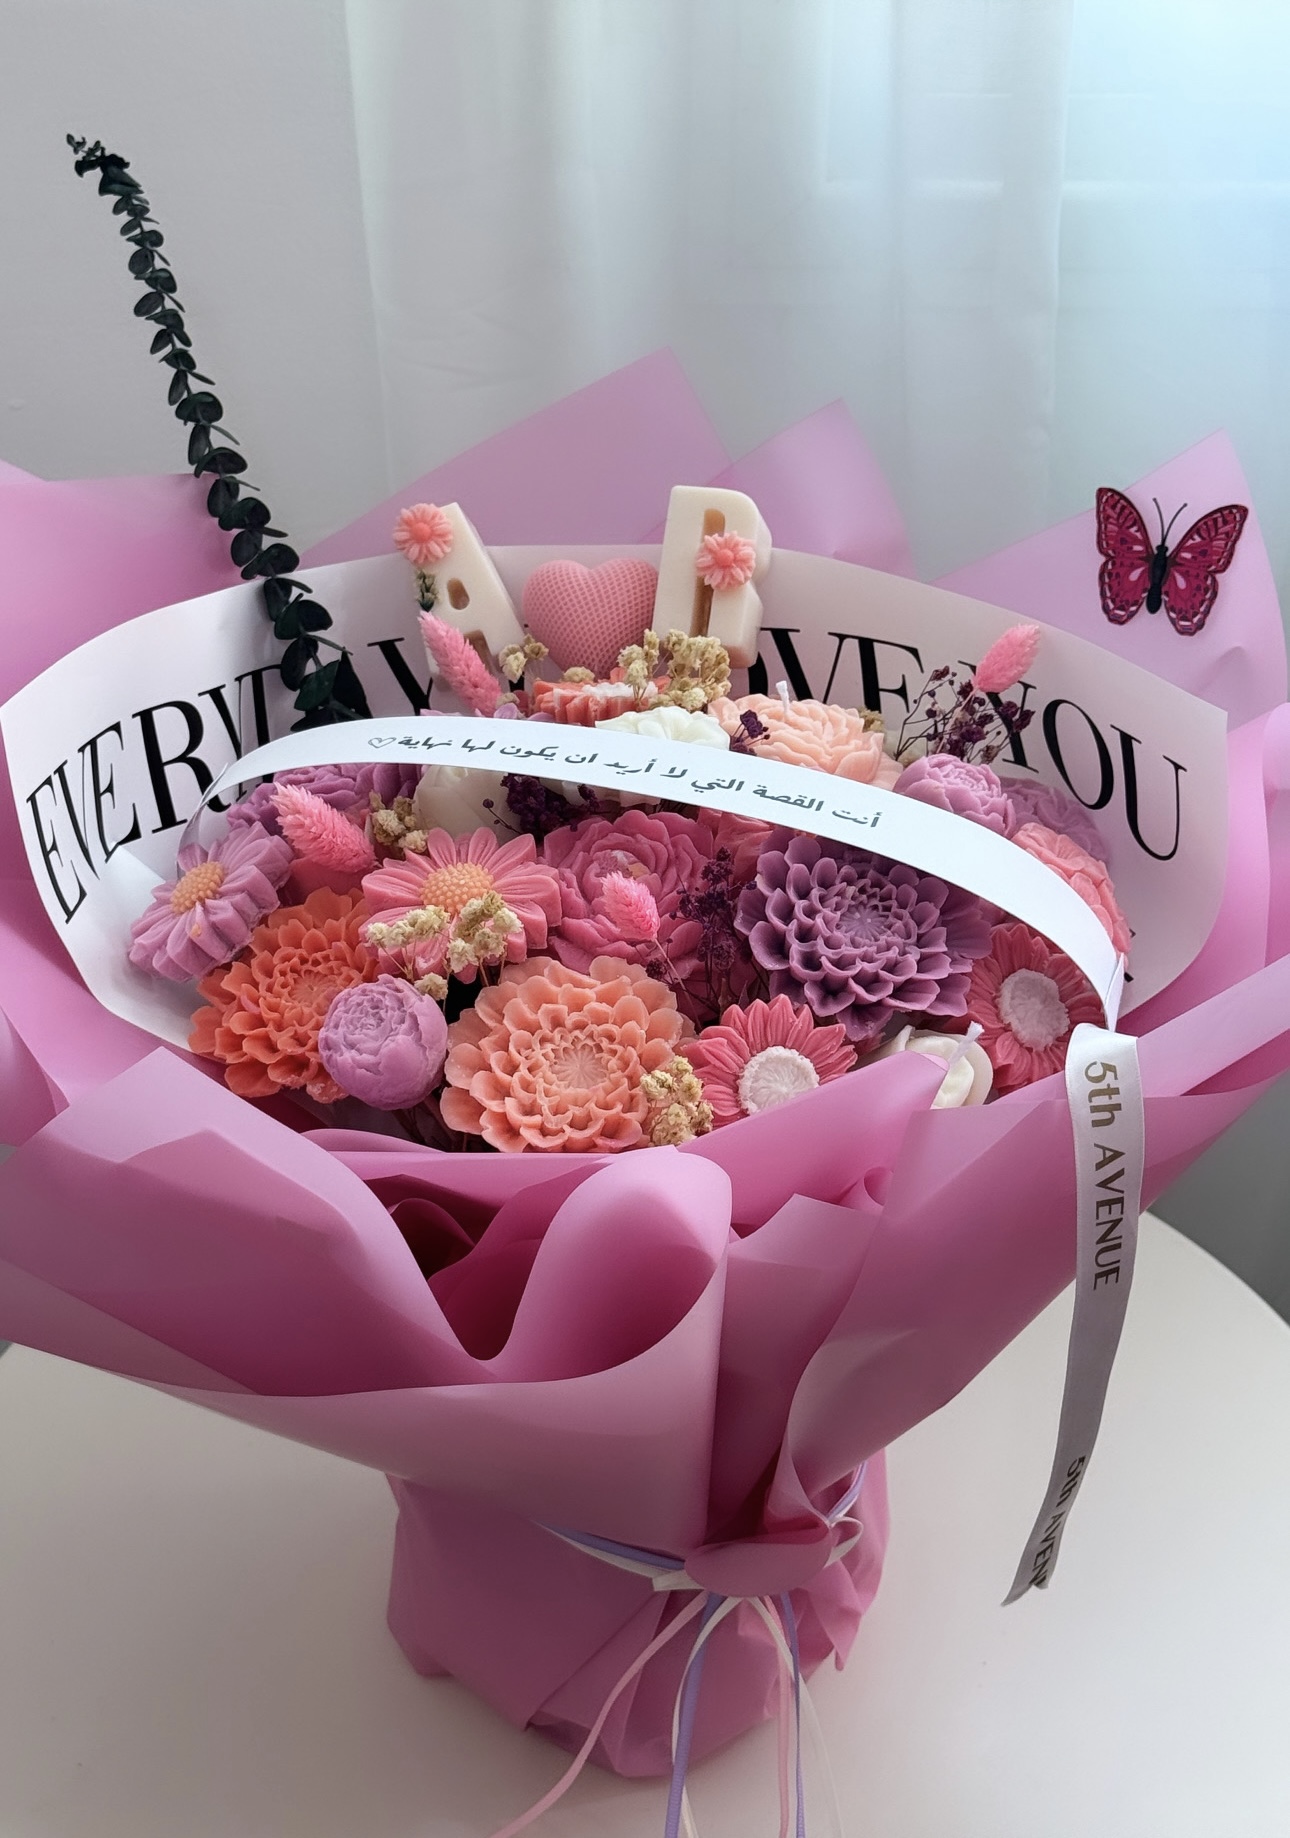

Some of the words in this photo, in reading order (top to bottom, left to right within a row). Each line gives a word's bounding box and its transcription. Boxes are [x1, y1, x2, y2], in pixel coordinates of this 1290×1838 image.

[397, 736, 453, 750] نهاية
[460, 738, 496, 753] لها
[499, 745, 559, 760] يكون
[957, 659, 1187, 861] YOU
[604, 758, 658, 775] أريد
[660, 766, 688, 779] لا
[690, 778, 746, 793] التي
[752, 784, 825, 812] القصة
[831, 811, 883, 828] أنت
[1084, 1061, 1122, 1128] 5th
[1093, 1142, 1126, 1291] AVENUE
[1056, 1455, 1086, 1508] 5th
